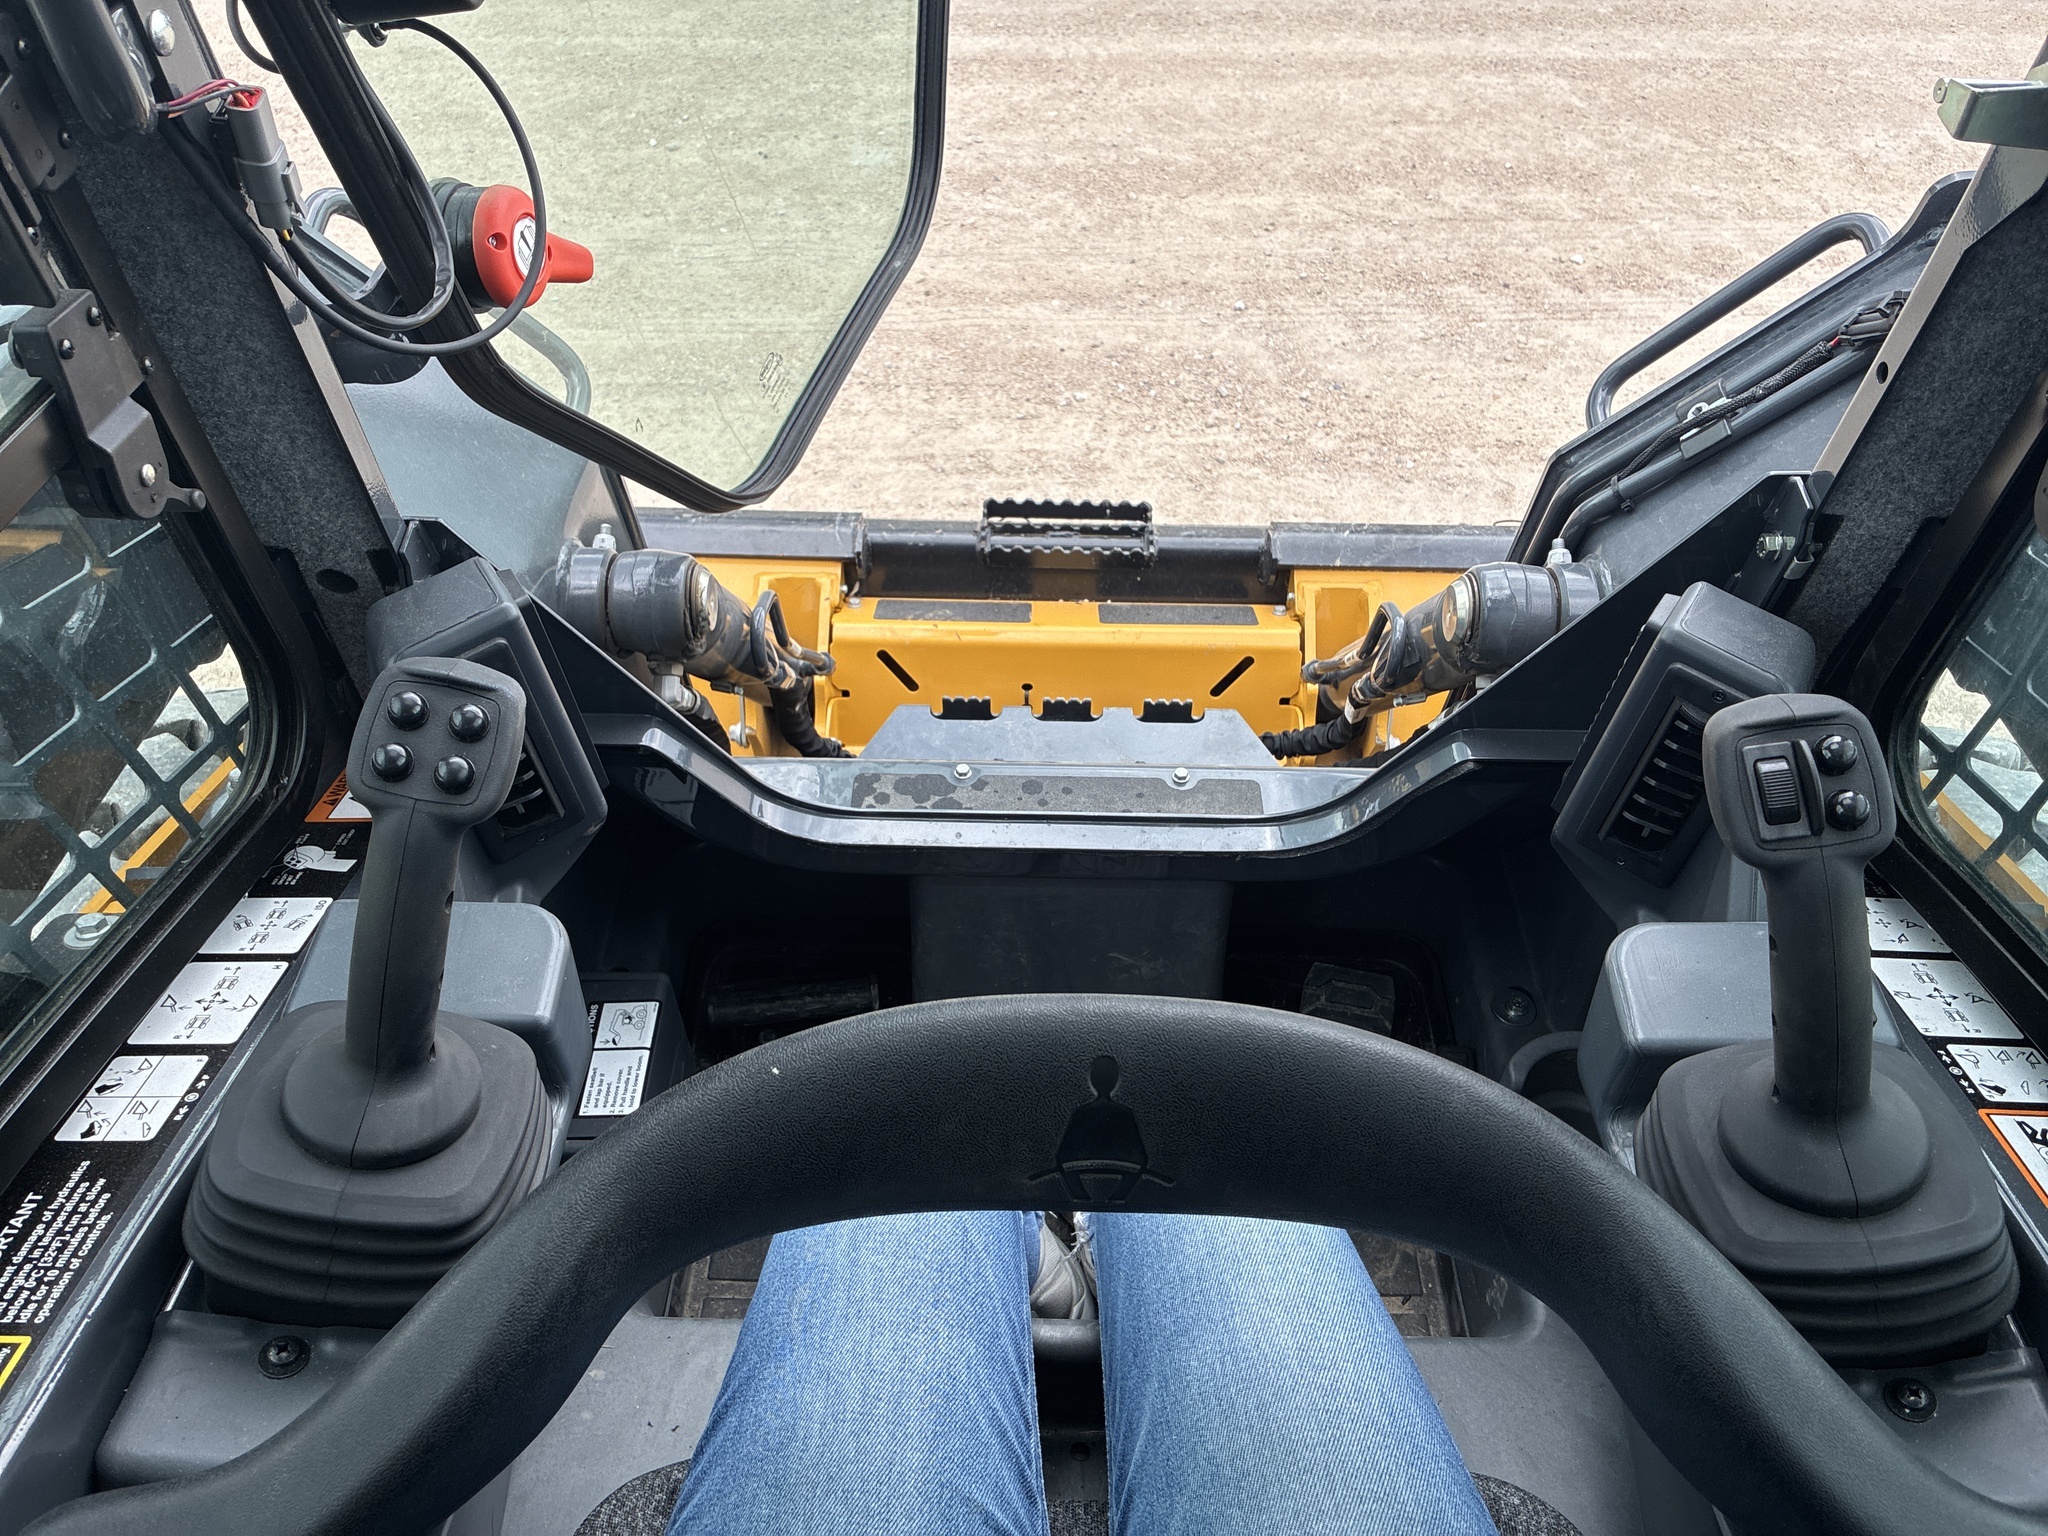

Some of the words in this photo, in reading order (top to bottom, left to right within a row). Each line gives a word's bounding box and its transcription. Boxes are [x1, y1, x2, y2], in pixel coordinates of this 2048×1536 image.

[314, 900, 327, 910] ISO
[584, 1090, 593, 1108] Fasten
[590, 1067, 598, 1088] seatbelt
[622, 1077, 630, 1095] handle
[632, 1073, 640, 1087] lower
[636, 1055, 644, 1071] boom.
[595, 1088, 603, 1096] lap
[603, 1081, 612, 1108] equipped.
[610, 1085, 620, 1107] Remove
[47, 1160, 91, 1210] hydraulics
[42, 1210, 55, 1221] of
[1, 1290, 31, 1323] below
[64, 1214, 82, 1231] run
[78, 1202, 91, 1212] at
[85, 1178, 107, 1201] slow
[3, 1260, 37, 1299] engine,
[28, 1247, 44, 1258] in
[38, 1181, 90, 1246] temperatures
[12, 1223, 46, 1263] damage
[15, 1302, 38, 1323] idle
[30, 1284, 49, 1301] for
[44, 1269, 60, 1282] 10
[55, 1226, 89, 1267] minutes
[81, 1193, 111, 1224] before
[34, 1271, 74, 1323] operation
[69, 1258, 82, 1269] of
[78, 1211, 114, 1256] controls.
